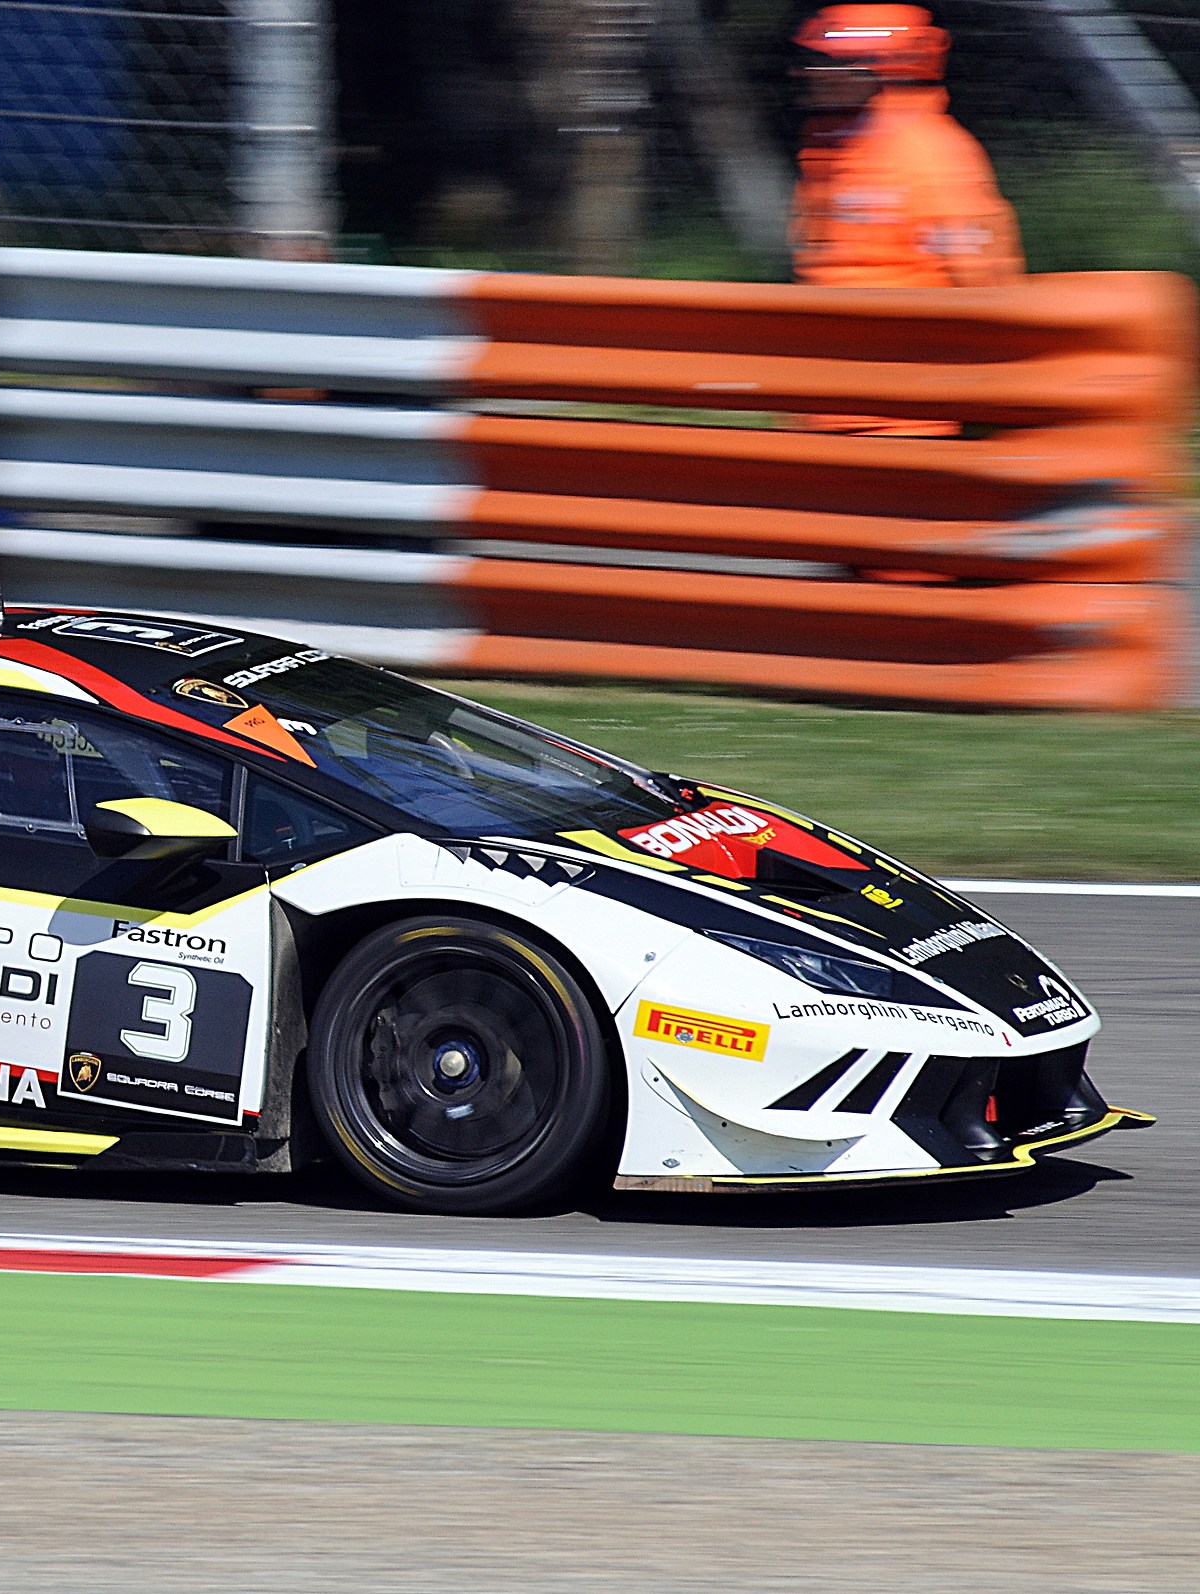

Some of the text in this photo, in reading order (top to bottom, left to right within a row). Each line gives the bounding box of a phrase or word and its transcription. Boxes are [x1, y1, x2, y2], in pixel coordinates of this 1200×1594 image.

[628, 806, 769, 859] BONALDI
[111, 919, 227, 954] Fastron
[888, 923, 977, 966] Lamborghini
[177, 951, 212, 964] Synthetic
[119, 960, 198, 1065] 3
[646, 1008, 756, 1052] PIRELLI
[772, 1001, 995, 1037] Lamborghini Bergamo
[1042, 1007, 1079, 1026] TURBO
[106, 1072, 235, 1103] SQUADRA CORSE
